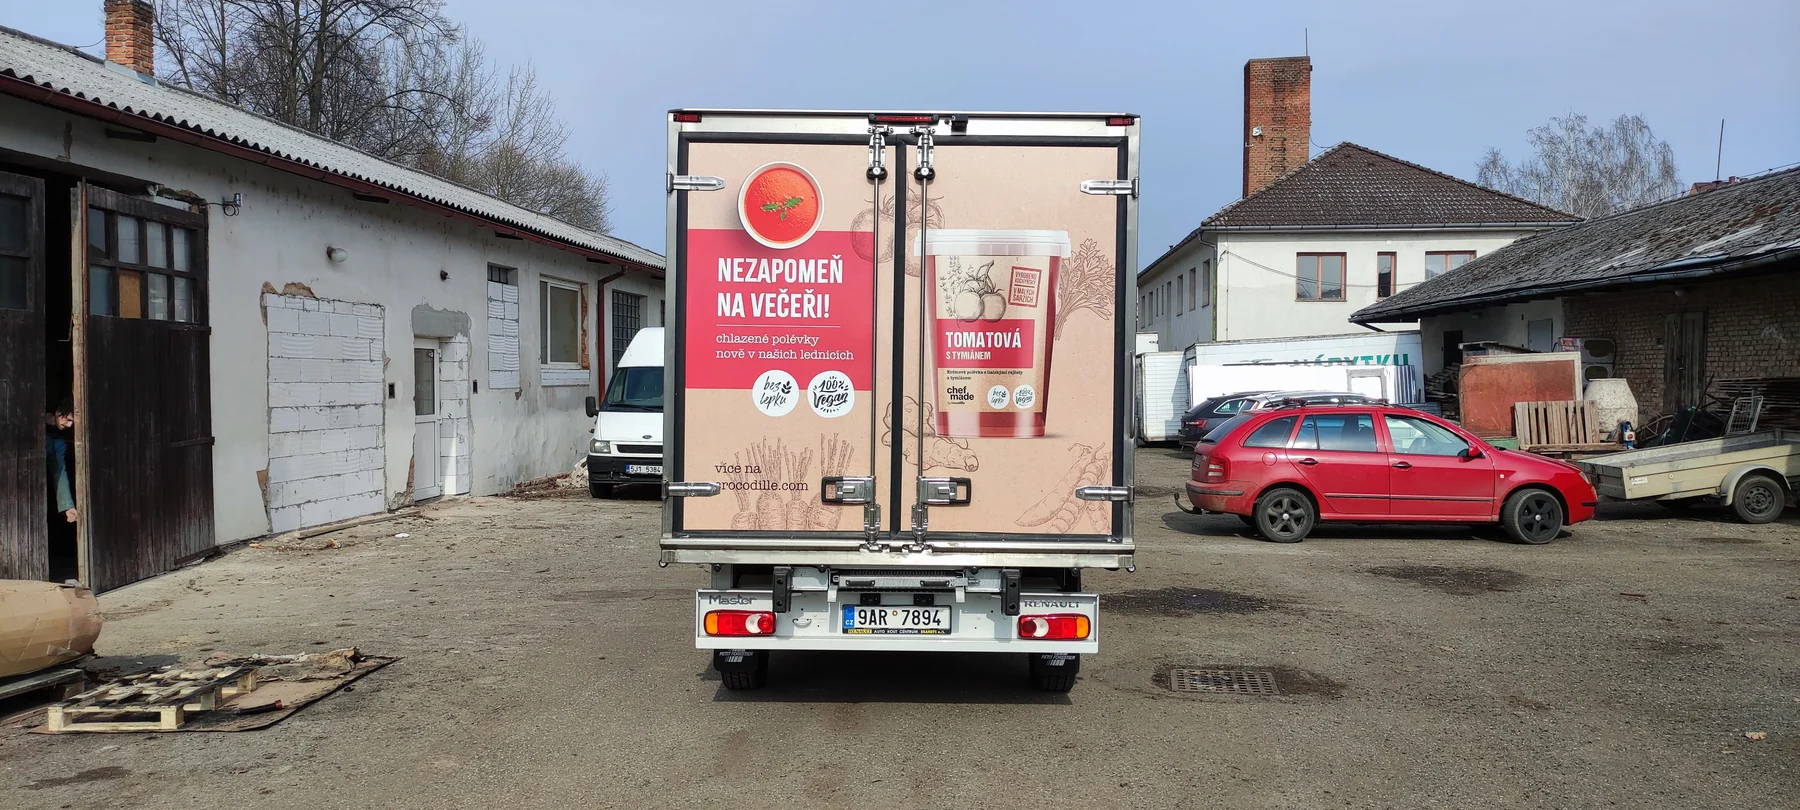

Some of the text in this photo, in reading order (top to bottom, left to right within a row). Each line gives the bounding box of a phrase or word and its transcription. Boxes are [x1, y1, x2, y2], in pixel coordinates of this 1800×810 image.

[718, 254, 843, 284] NEZAPOMEŇ
[717, 288, 830, 318] NA VEČEŘI!
[716, 334, 820, 346] chlazené polévky
[945, 328, 1022, 348] TOMATOVÁ
[716, 349, 745, 359] nově
[758, 349, 798, 360] našich
[800, 350, 855, 360] lednicích
[946, 349, 991, 360] S TYMIÁNEM
[764, 376, 781, 392] bez
[818, 380, 844, 393] 100%
[947, 386, 967, 394] chef
[760, 392, 787, 409] lepku
[813, 391, 848, 408] Vegan
[950, 392, 975, 401] made
[715, 460, 761, 474] více na
[709, 594, 757, 605] Master
[1024, 600, 1081, 608] RENAULT
[858, 609, 888, 626] 9AR
[901, 609, 941, 626] 7894
